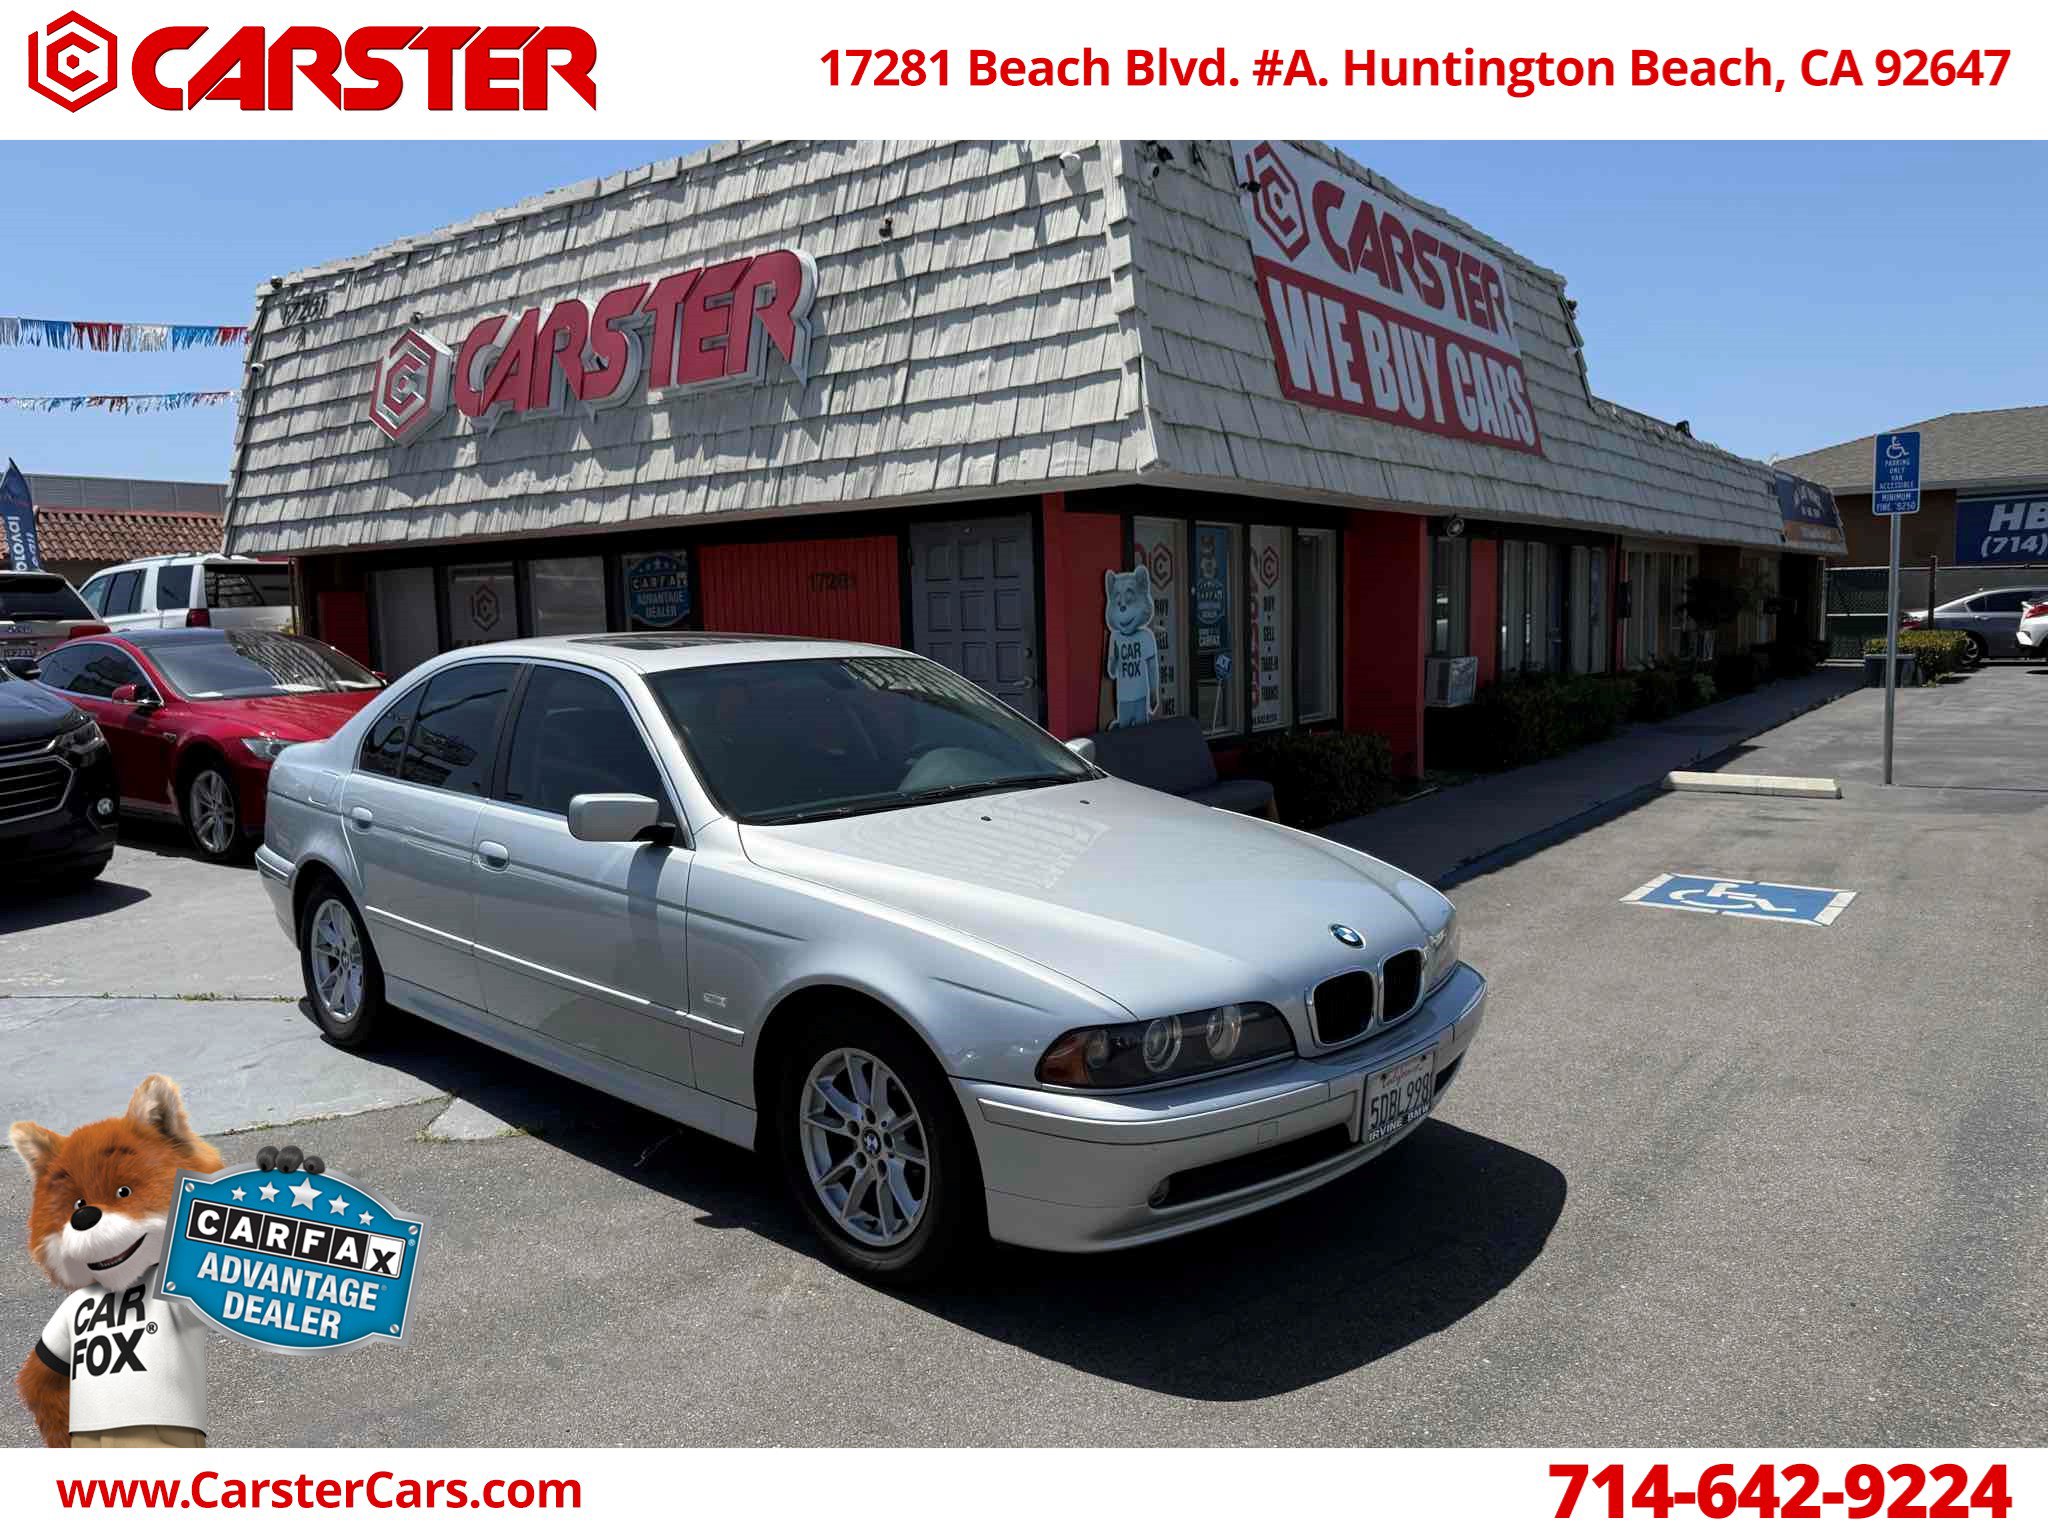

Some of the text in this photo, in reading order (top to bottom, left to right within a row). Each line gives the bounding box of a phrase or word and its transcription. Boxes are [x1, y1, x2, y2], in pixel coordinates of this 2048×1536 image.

[1312, 180, 1513, 340] CARSTER
[453, 248, 806, 418] CARSTER
[1267, 276, 1536, 447] WE BUY CARS
[1881, 492, 1911, 501] MINIMUM
[1981, 533, 2048, 558] (714)
[1121, 642, 1141, 660] CAR
[1121, 662, 1141, 677] FOX
